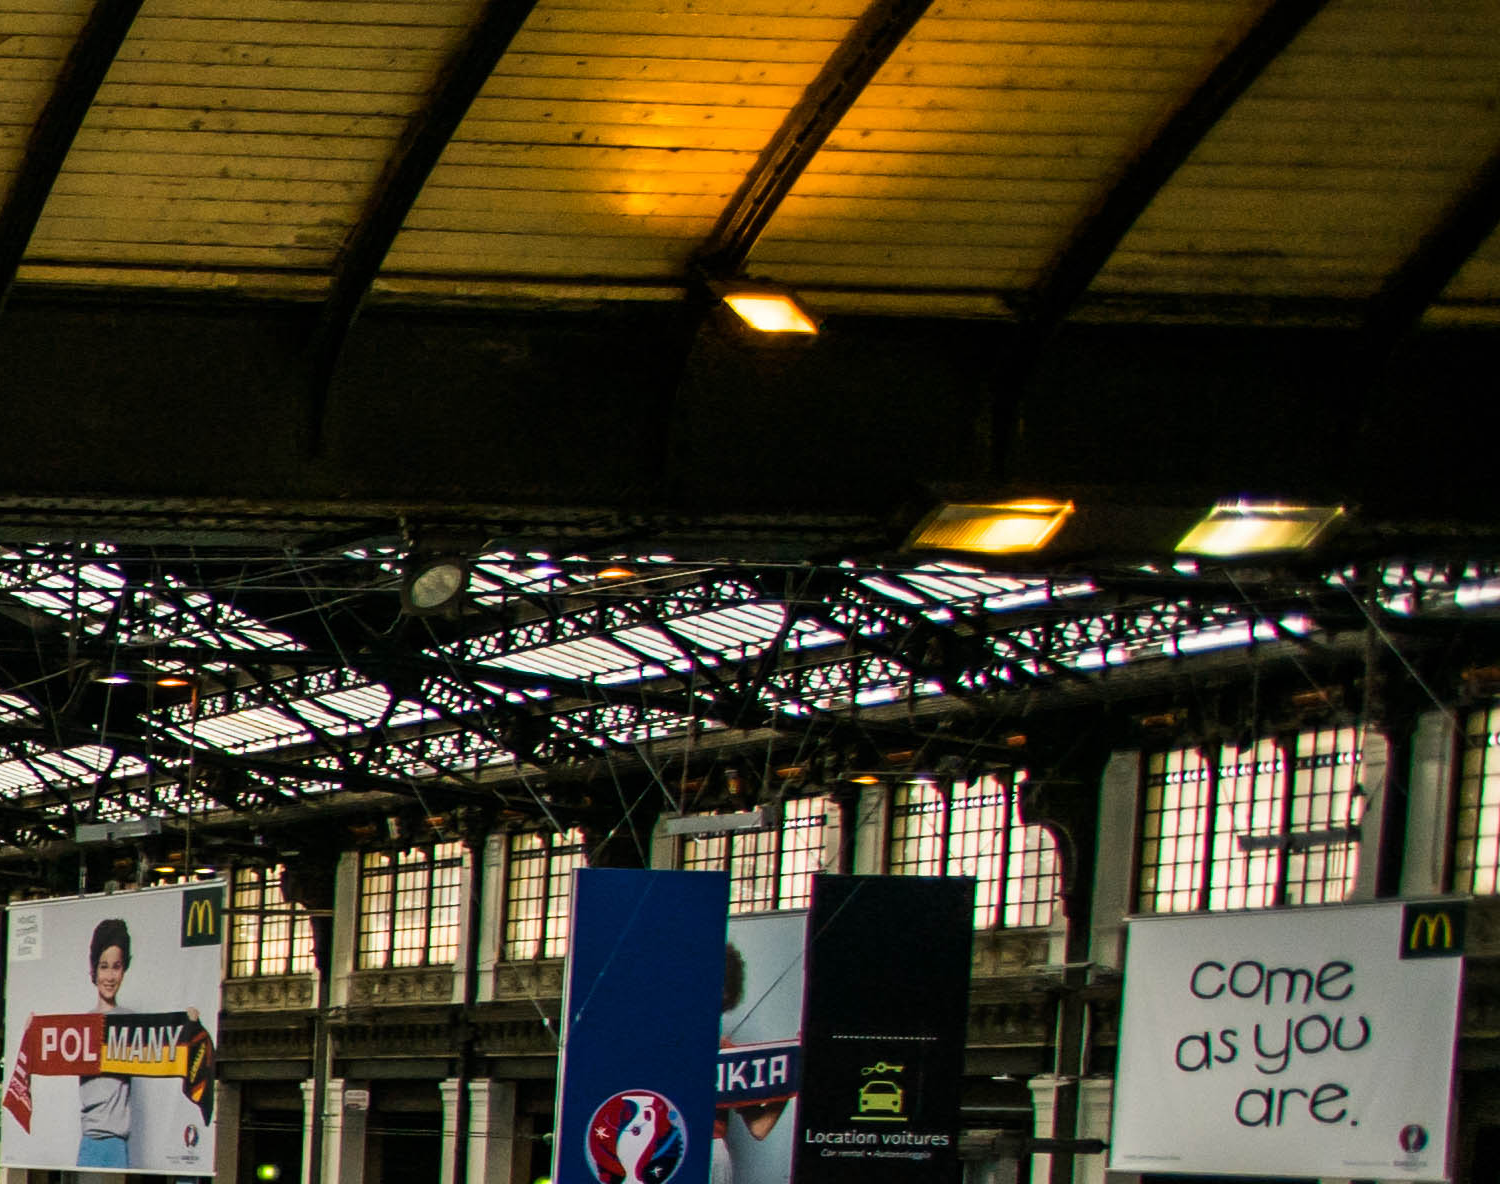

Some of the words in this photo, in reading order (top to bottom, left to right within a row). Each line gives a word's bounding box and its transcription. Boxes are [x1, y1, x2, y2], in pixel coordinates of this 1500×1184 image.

[1190, 960, 1354, 1005] come
[41, 1027, 97, 1062] POL
[106, 1025, 184, 1062] MANY
[1175, 1029, 1238, 1072] as
[1254, 1014, 1371, 1075] you
[1235, 1083, 1358, 1127] are.
[805, 1129, 877, 1144] Location
[882, 1131, 950, 1146] voitures
